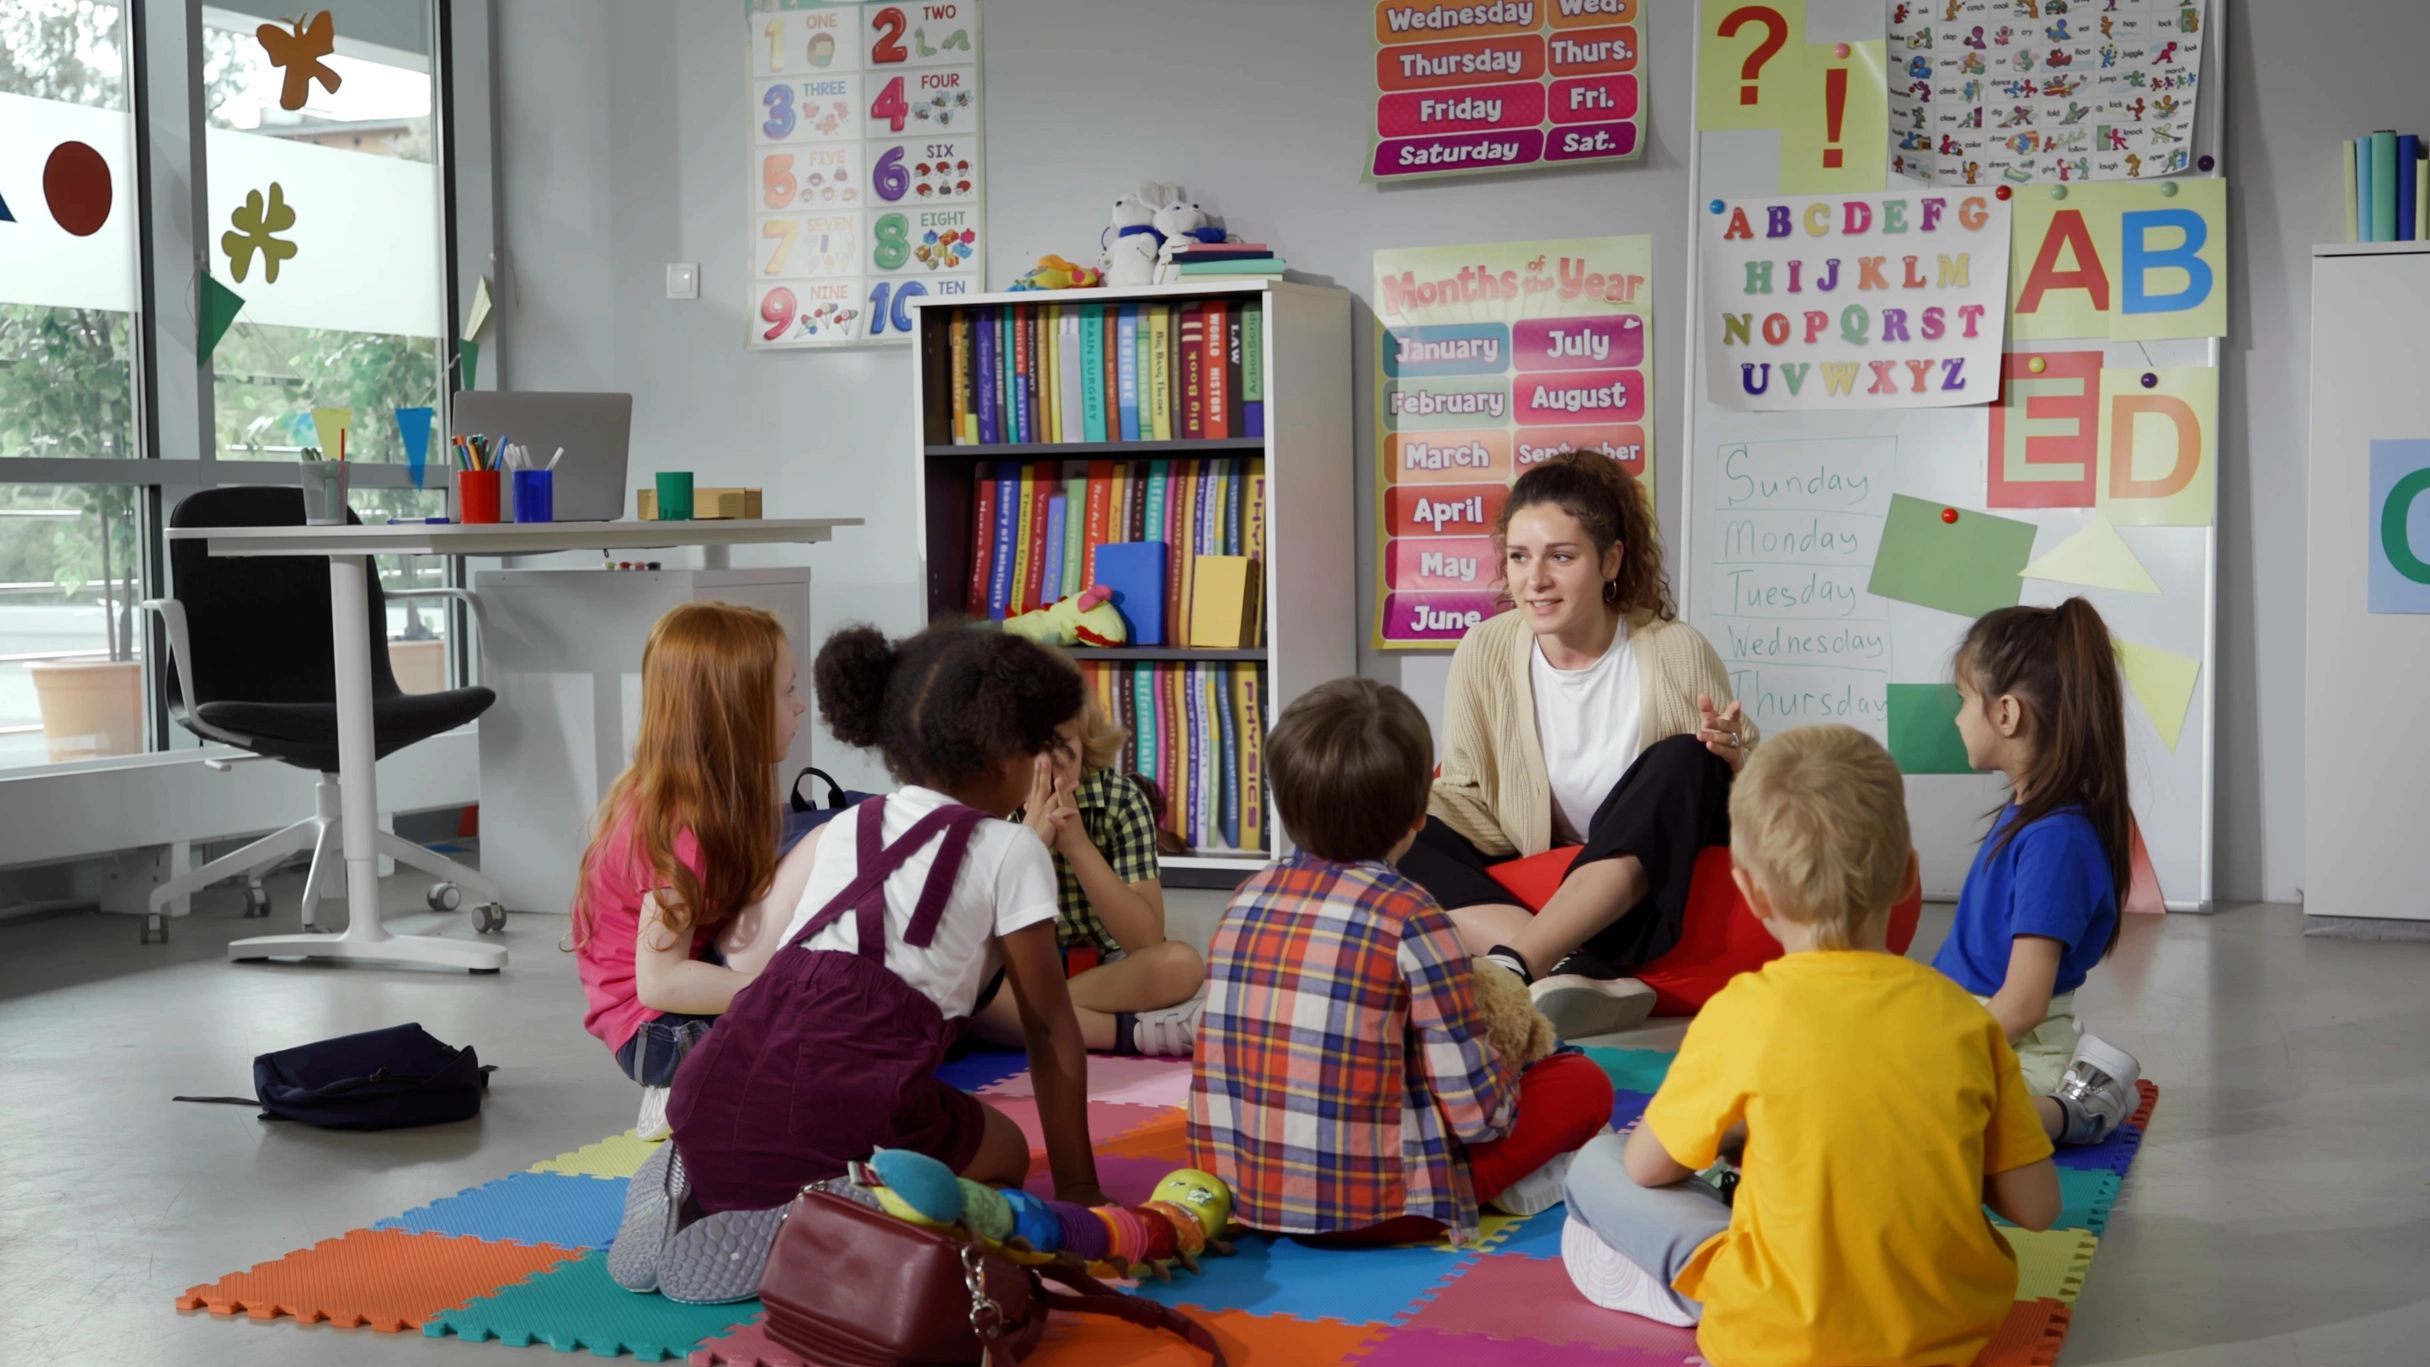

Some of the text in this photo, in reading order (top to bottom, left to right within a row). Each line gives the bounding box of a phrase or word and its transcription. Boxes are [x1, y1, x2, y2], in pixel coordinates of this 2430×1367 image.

[805, 13, 838, 30] ONE
[871, 7, 908, 64] 2
[923, 4, 957, 22] TWO
[1387, 0, 1533, 33] Wednesday
[764, 16, 785, 72] 1
[1399, 48, 1522, 78] Thursday
[1550, 39, 1634, 65] Thurs.
[802, 79, 847, 98] THREE
[920, 72, 960, 89] FOUR
[1569, 86, 1615, 111] Fri.
[762, 83, 797, 140] 3
[870, 76, 909, 133] 4
[1419, 97, 1503, 123] Friday
[809, 150, 846, 167] FIVE
[926, 144, 954, 159] SIX
[1398, 140, 1520, 167] Saturday
[1562, 130, 1617, 153] Sat.
[762, 153, 798, 210] 5
[872, 145, 911, 203] 6
[806, 215, 854, 233] SEVEN
[873, 212, 911, 271] 8
[919, 211, 966, 228] EIGHT
[762, 218, 800, 275] 7
[2014, 208, 2110, 314] A
[2121, 207, 2214, 316] B
[809, 284, 848, 301] NINE
[937, 280, 966, 296] TEN
[1382, 255, 1645, 316] Months of the Year
[760, 286, 797, 341] 9
[1121, 325, 1133, 400] MEDICINE
[1230, 323, 1240, 365] LAW
[1394, 336, 1500, 365] January
[1546, 328, 1610, 361] July
[953, 335, 963, 412] Chemistry
[1086, 359, 1096, 422] SURGERY
[1209, 312, 1222, 423] WORLD HISTORY
[1017, 376, 1027, 438] POLITICS
[1187, 350, 1199, 432] Big Book
[1389, 389, 1505, 418] February
[1530, 381, 1626, 413] August
[2003, 377, 2086, 483] E
[2108, 393, 2202, 499] D
[1405, 440, 1490, 471] March
[1725, 443, 1870, 507] Sunday
[1001, 480, 1013, 526] Theory
[1412, 495, 1484, 532] April
[1030, 492, 1045, 590] Vector Analysis
[1171, 475, 1185, 602] University Physics
[1723, 518, 1858, 560] Monday
[993, 544, 1009, 610] Relativity
[1419, 551, 1478, 582] May
[1727, 568, 1857, 617] Tuesday
[1409, 605, 1483, 632] June
[1728, 624, 1885, 659] Wednesday
[1729, 669, 1888, 722] Thursday
[1165, 673, 1176, 802] University Physics
[1244, 680, 1259, 830] PHYSICS
